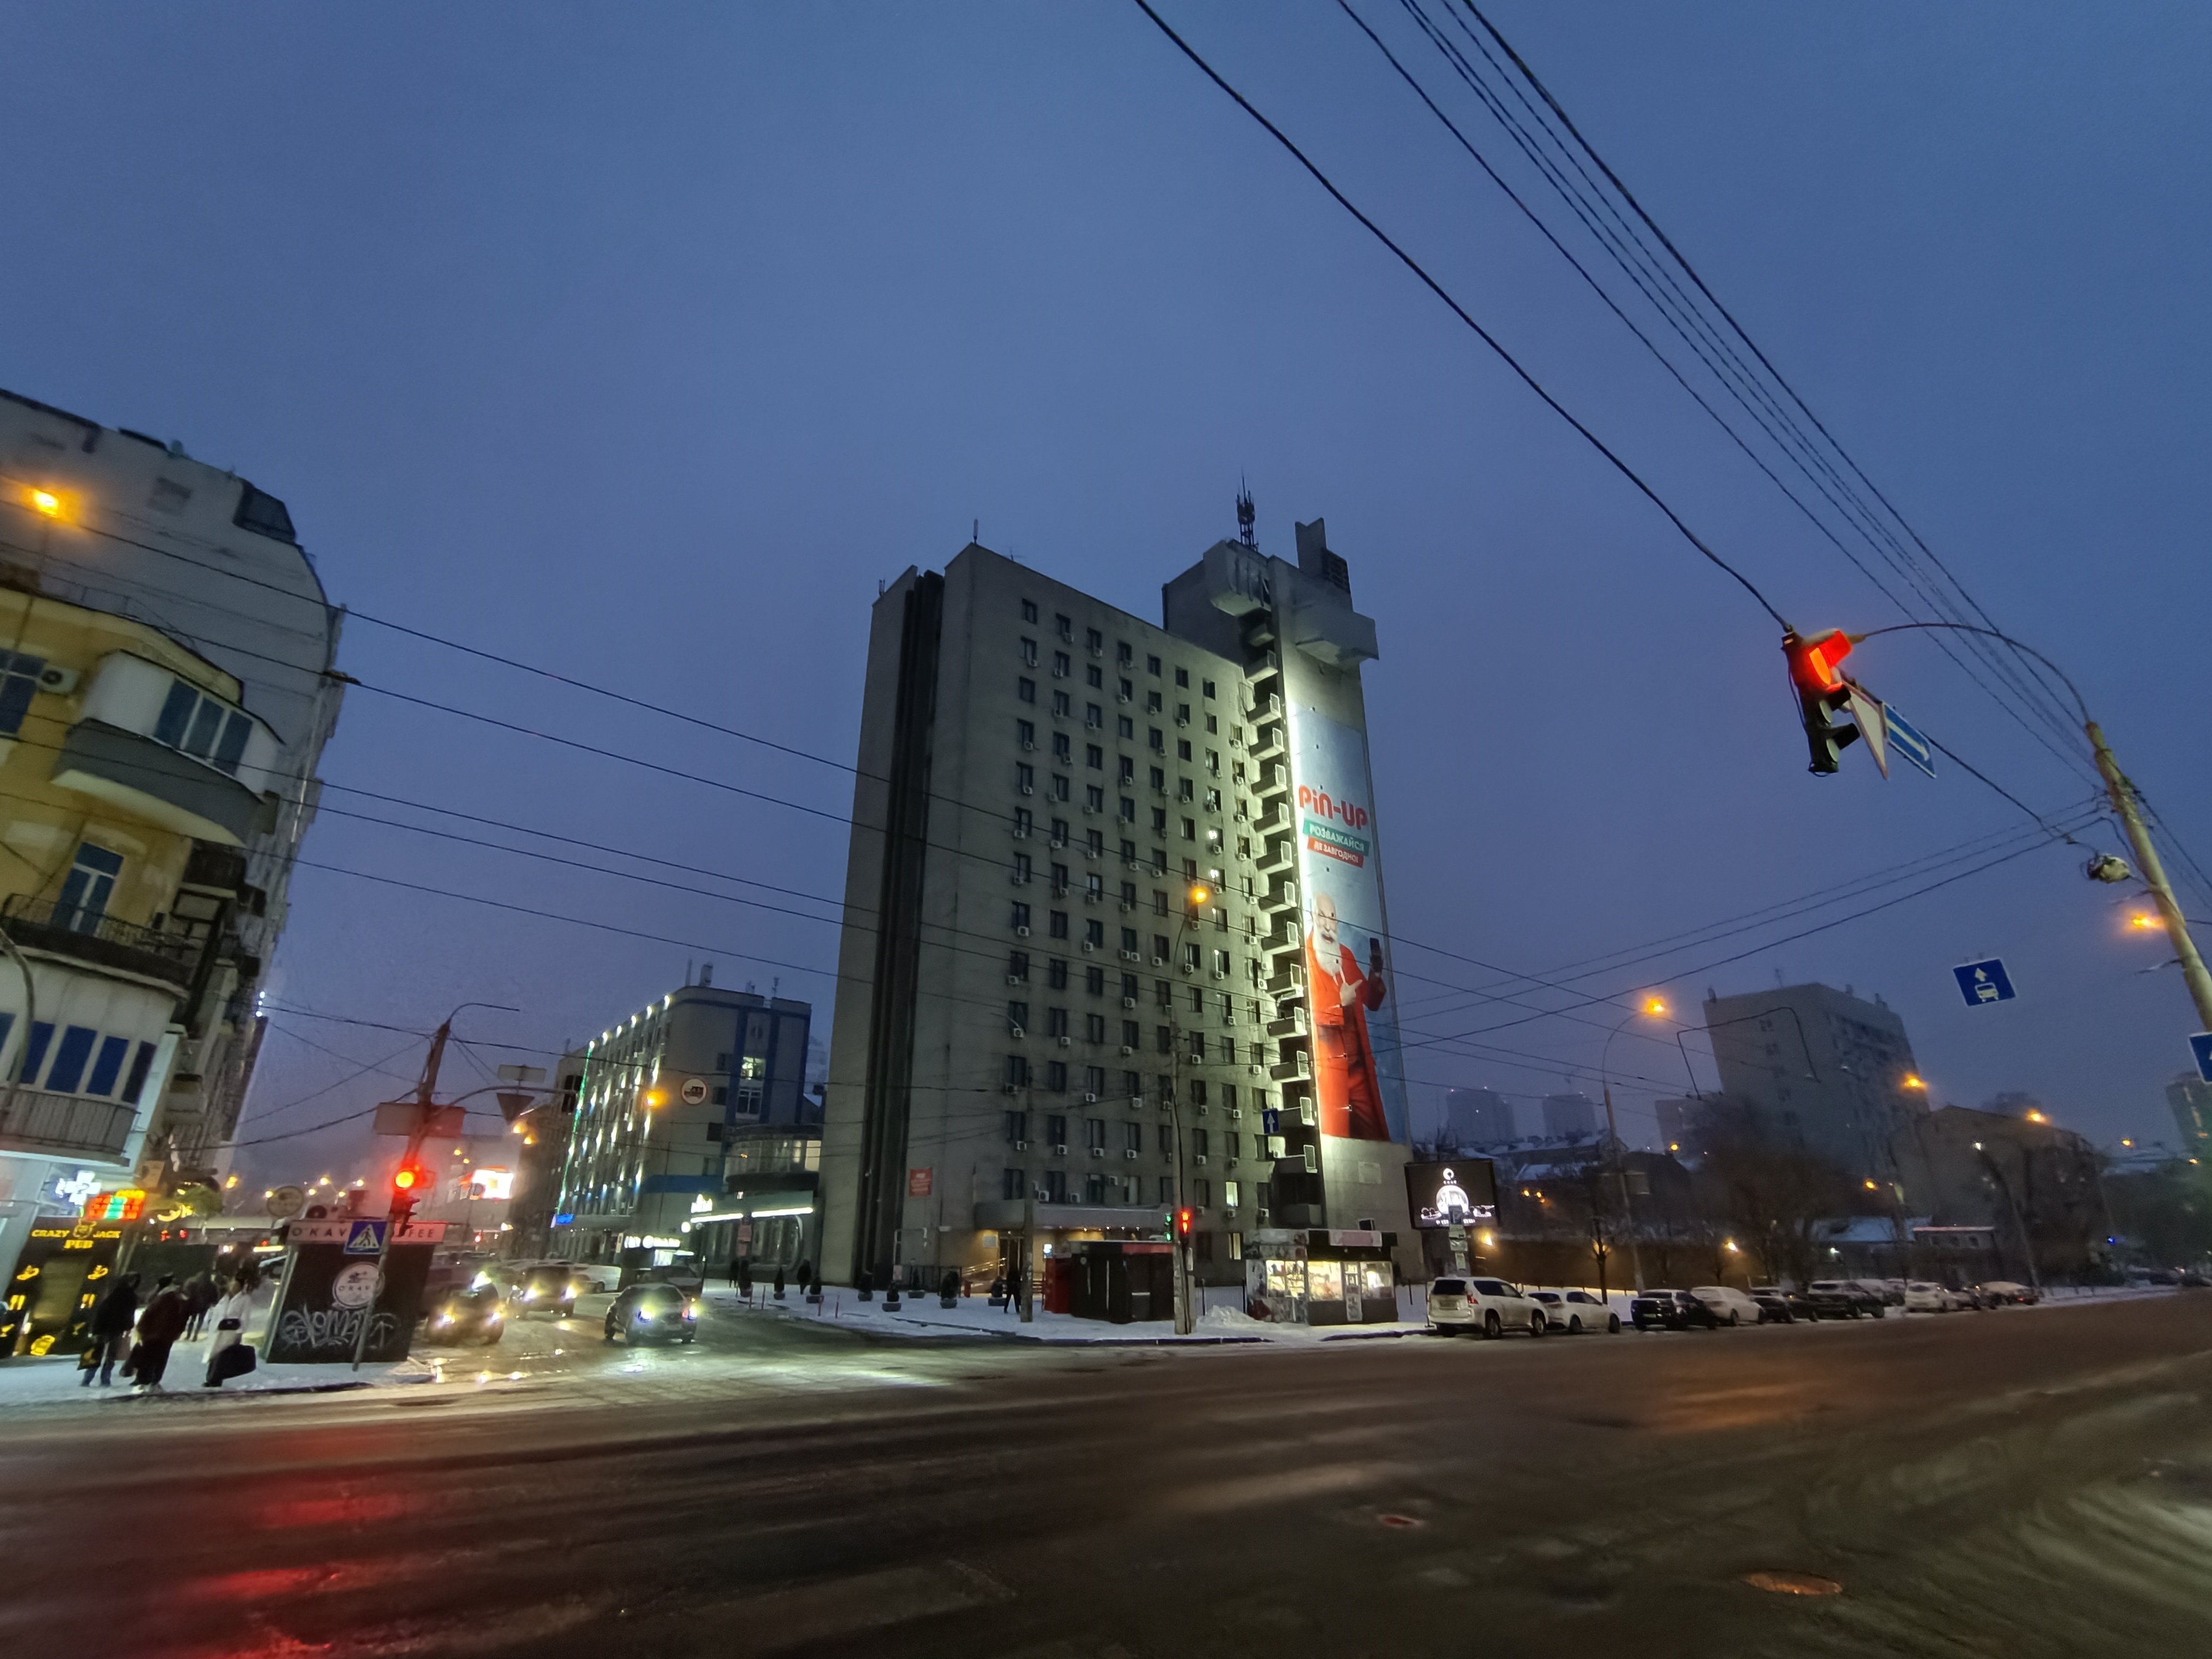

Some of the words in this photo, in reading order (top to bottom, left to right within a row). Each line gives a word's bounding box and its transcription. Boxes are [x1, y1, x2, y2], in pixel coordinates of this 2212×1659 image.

[1310, 824, 1364, 852] РОЗВАЖАЙСЯ
[32, 1230, 70, 1238] CRAZY
[64, 1239, 93, 1249] PUB
